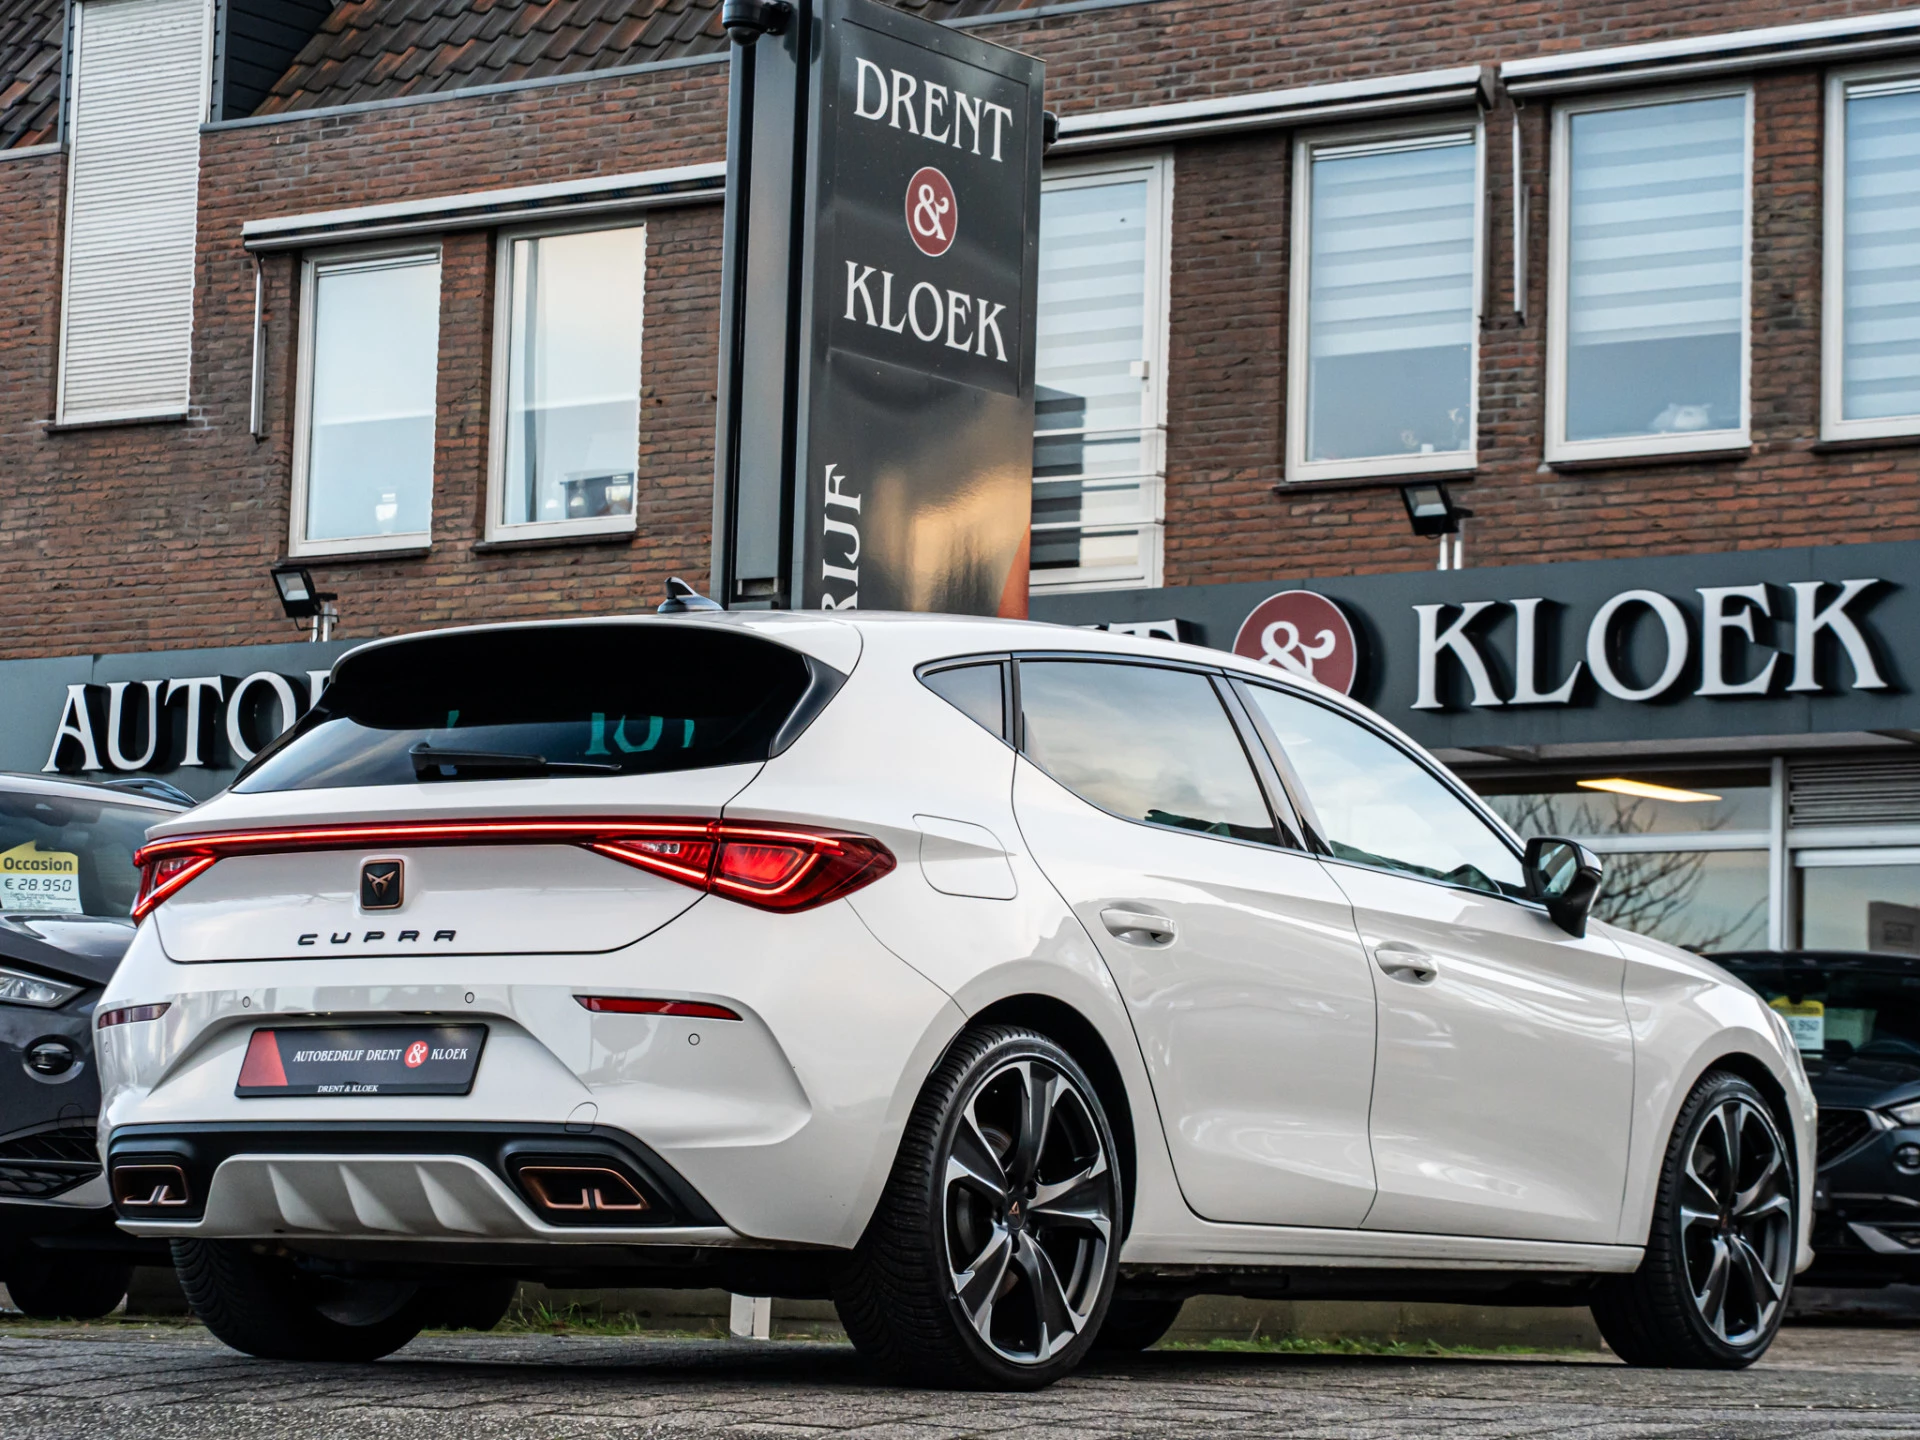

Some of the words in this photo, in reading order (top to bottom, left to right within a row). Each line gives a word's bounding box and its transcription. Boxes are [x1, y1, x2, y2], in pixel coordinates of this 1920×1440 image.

[854, 57, 1013, 162] DRENT
[913, 184, 950, 241] &
[843, 260, 1008, 362] KLOEK
[41, 670, 331, 773] AUTO
[1410, 578, 1889, 709] KLOEK
[4, 857, 72, 871] Occasion
[18, 878, 72, 892] 28.950
[298, 930, 456, 946] CUPRA
[293, 1049, 365, 1062] AUTOBEDRIJF
[365, 1049, 402, 1061] DRENT
[407, 1043, 427, 1065] &
[431, 1048, 469, 1060] KLOEK
[317, 1084, 344, 1093] DRENT
[351, 1084, 379, 1092] KLOEK
